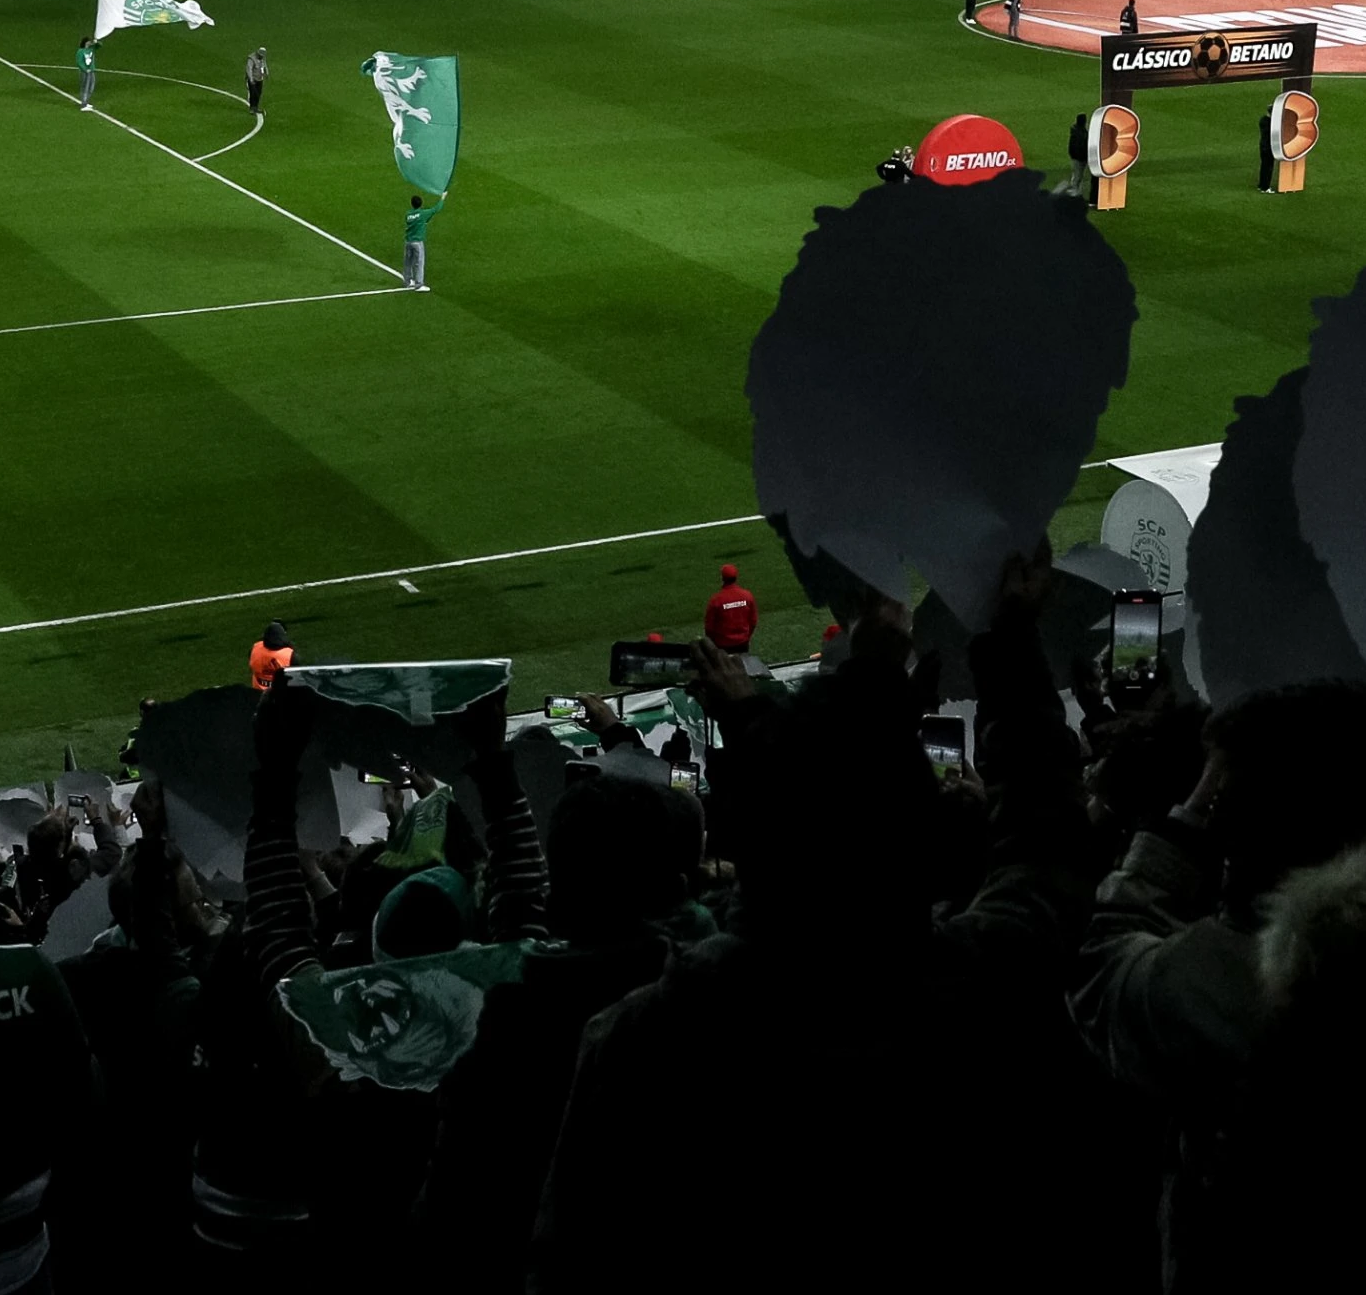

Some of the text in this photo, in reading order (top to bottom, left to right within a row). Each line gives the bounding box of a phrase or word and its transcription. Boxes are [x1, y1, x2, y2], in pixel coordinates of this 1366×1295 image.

[1112, 42, 1293, 71] CLÁSSICO BETANO
[1137, 519, 1166, 537] SCP
